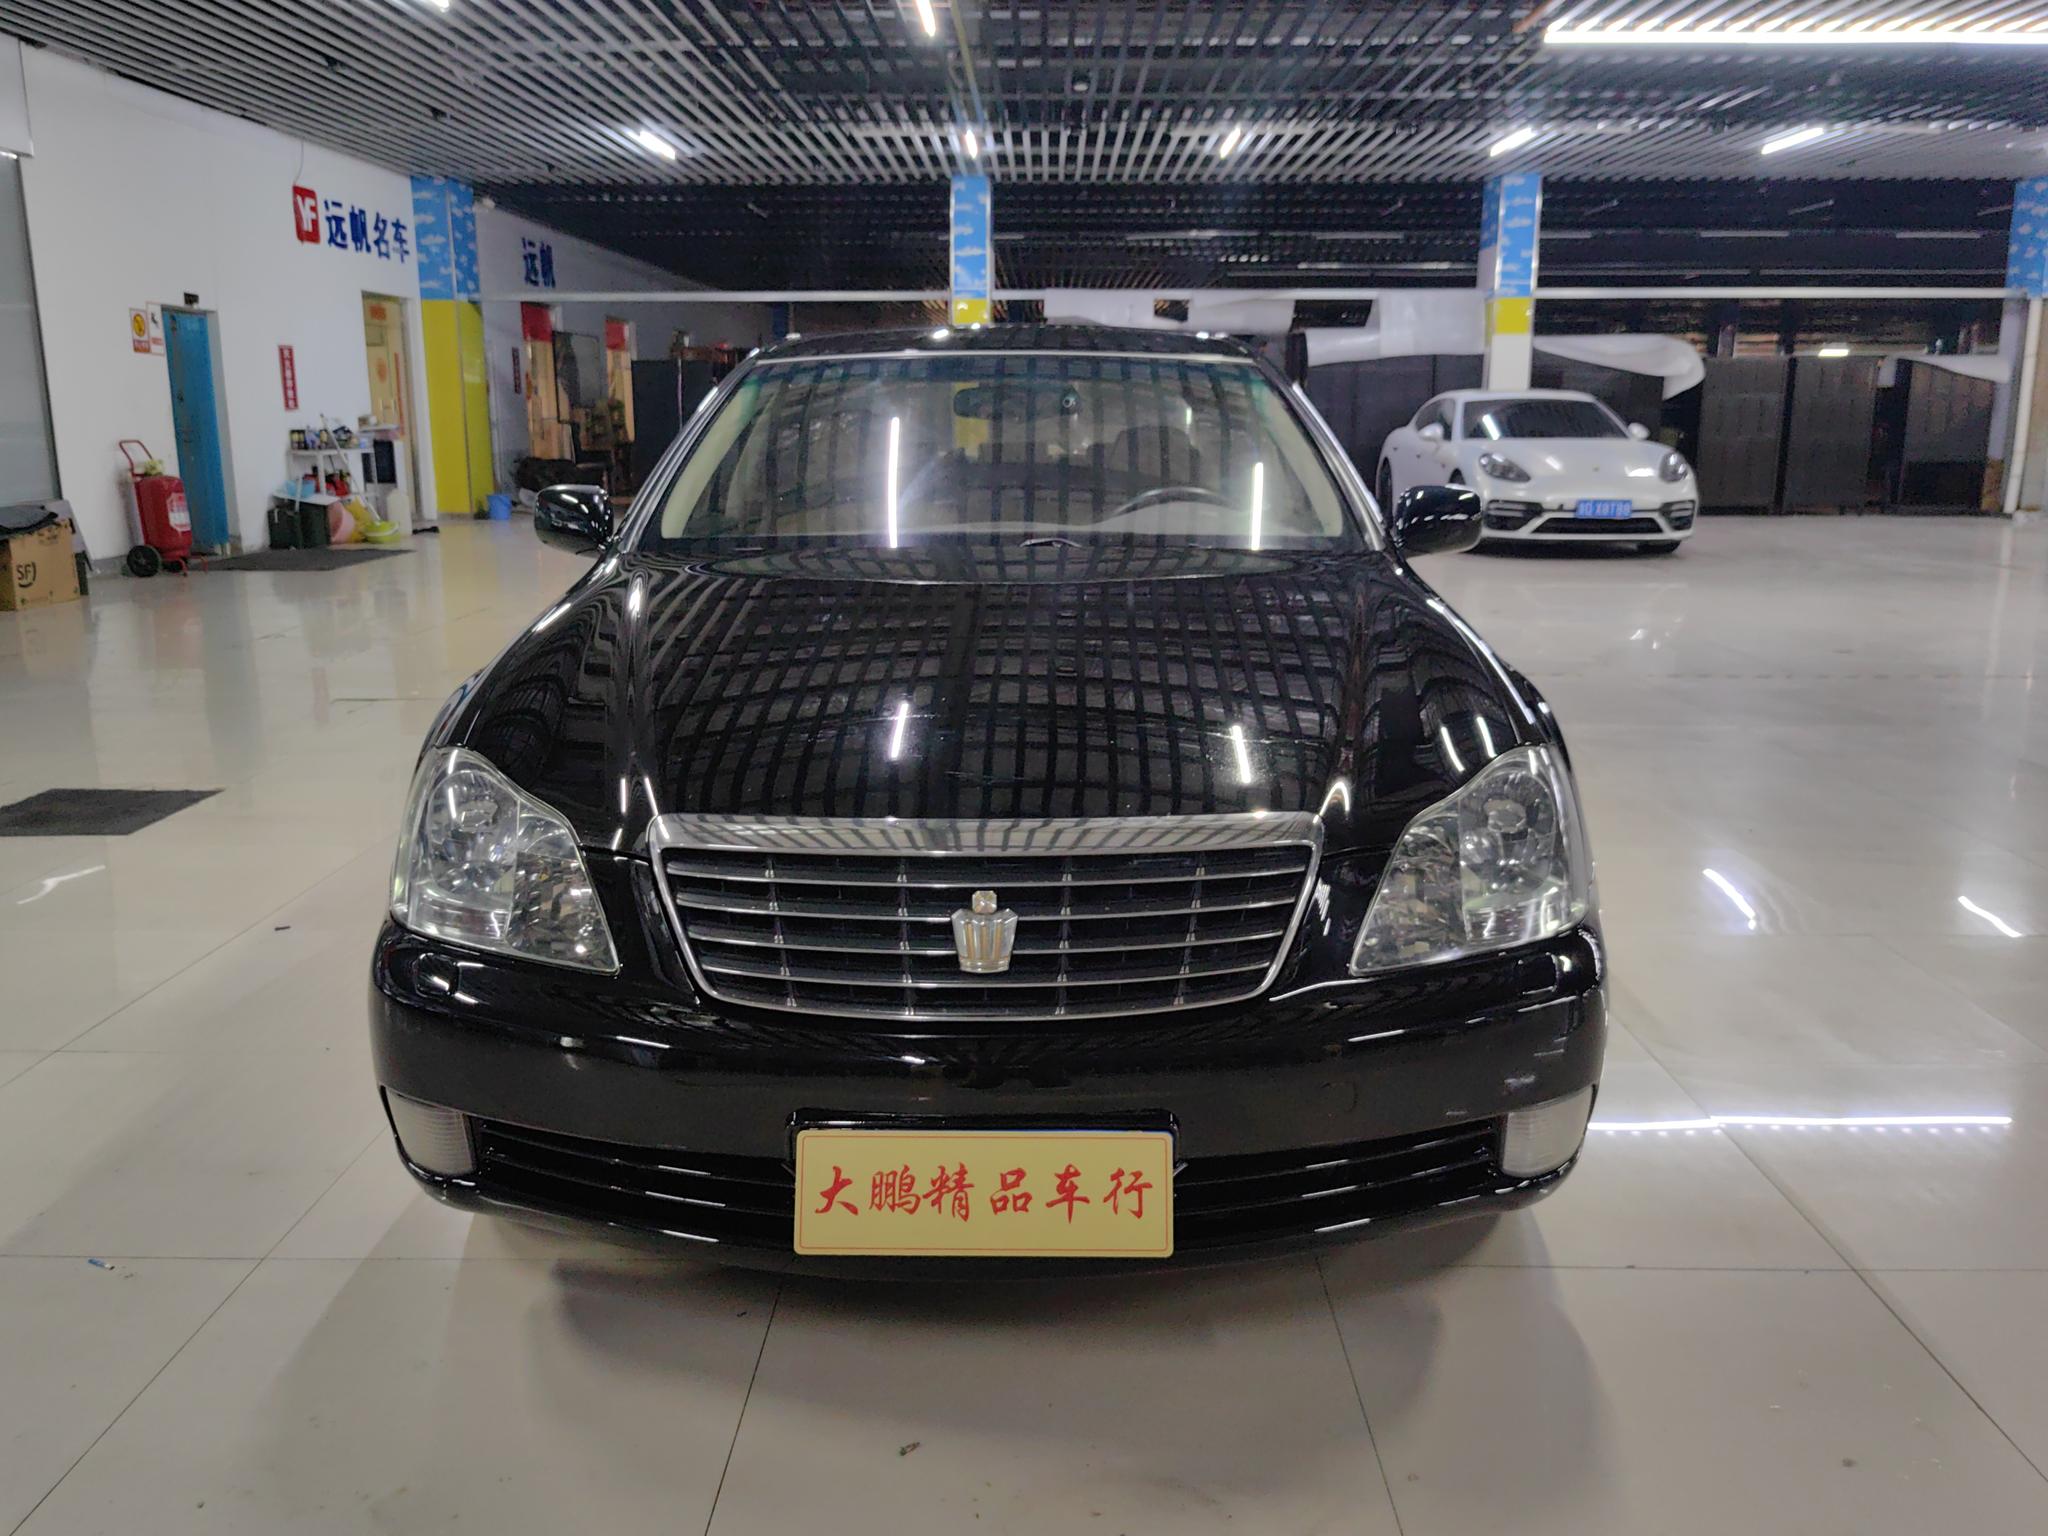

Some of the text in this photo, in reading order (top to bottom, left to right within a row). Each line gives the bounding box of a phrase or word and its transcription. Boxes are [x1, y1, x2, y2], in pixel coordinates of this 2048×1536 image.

[324, 199, 410, 264] 远帆名车
[521, 236, 556, 288] 远帆
[814, 1162, 1154, 1224] 大鹏精品车行
